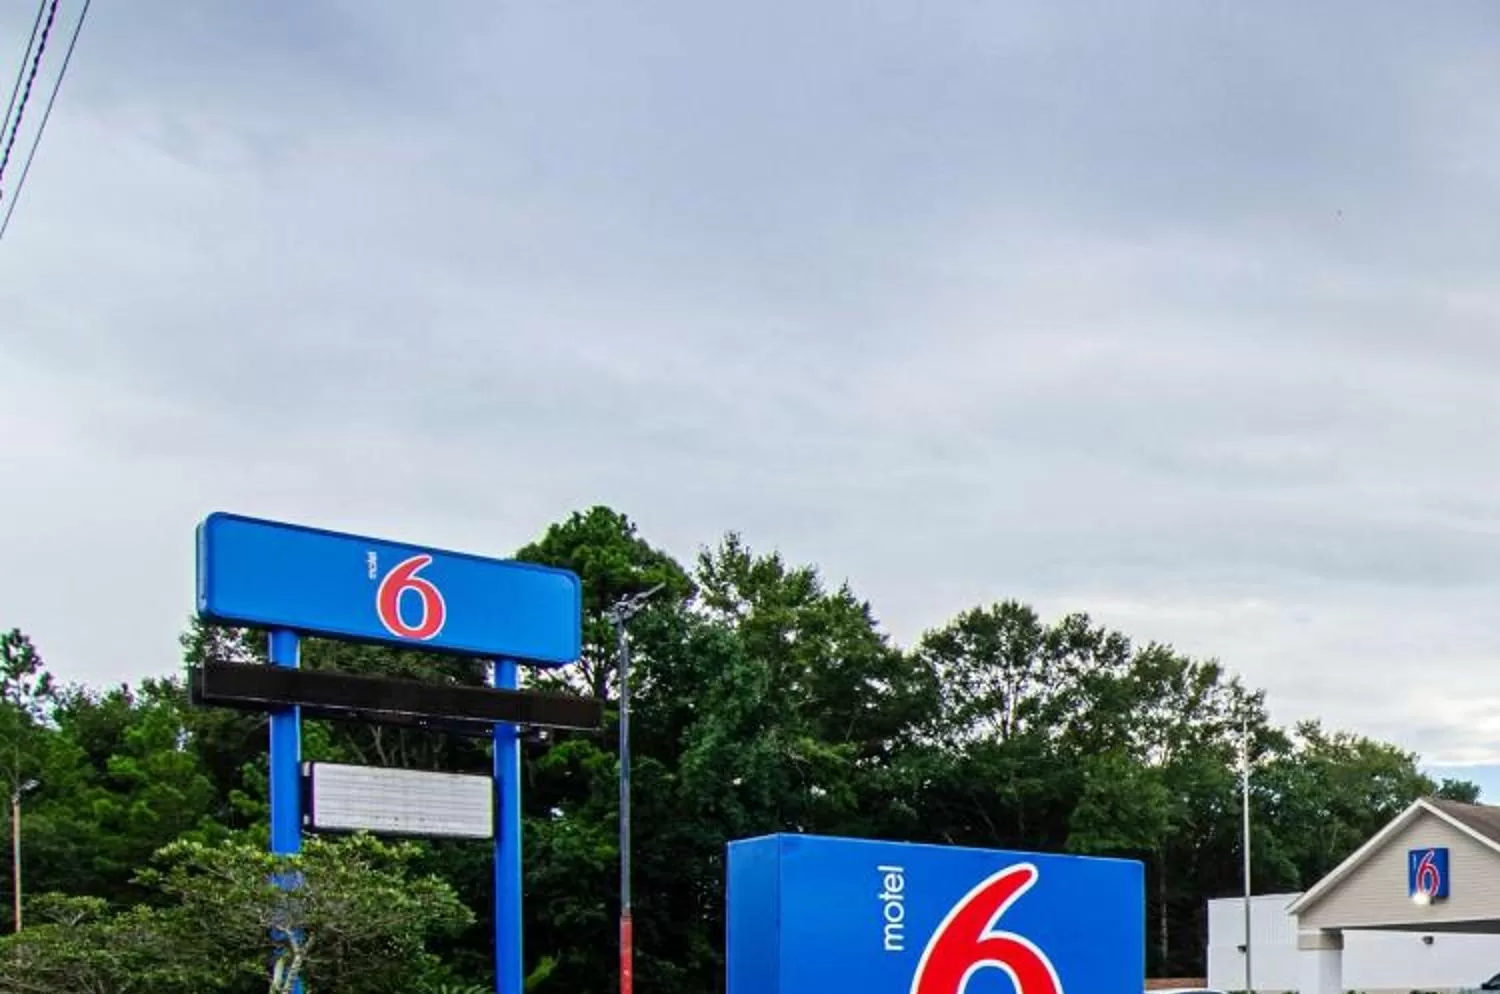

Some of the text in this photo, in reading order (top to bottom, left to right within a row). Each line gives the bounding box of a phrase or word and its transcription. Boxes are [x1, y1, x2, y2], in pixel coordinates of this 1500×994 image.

[376, 553, 446, 640] 6
[877, 865, 904, 951] motel
[1416, 849, 1440, 897] 6
